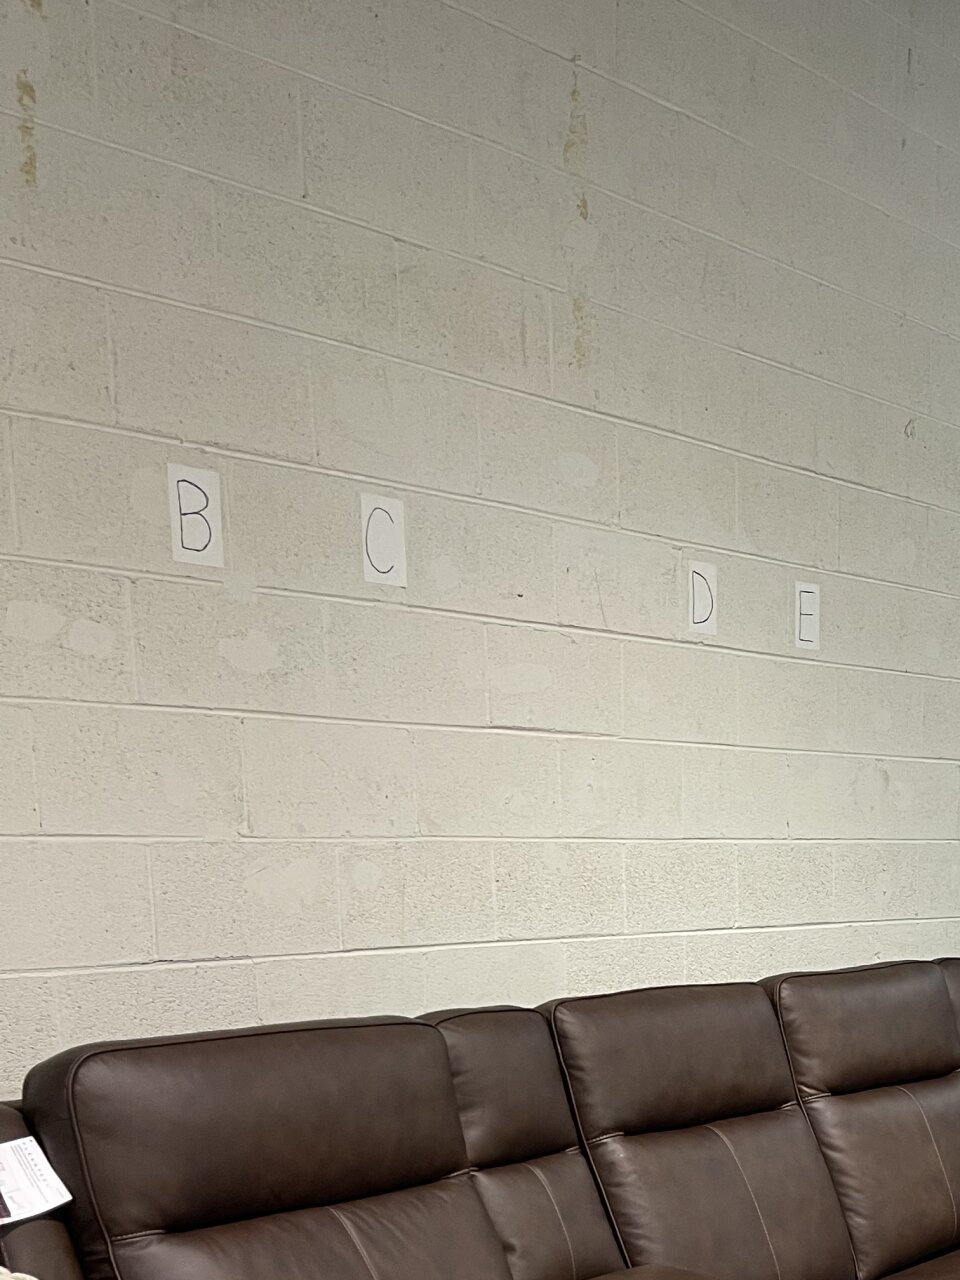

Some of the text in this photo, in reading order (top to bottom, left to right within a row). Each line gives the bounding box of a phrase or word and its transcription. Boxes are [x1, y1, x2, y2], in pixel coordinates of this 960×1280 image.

[176, 479, 212, 552] B
[365, 507, 395, 574] C
[692, 570, 714, 625] D
[799, 590, 815, 643] E
